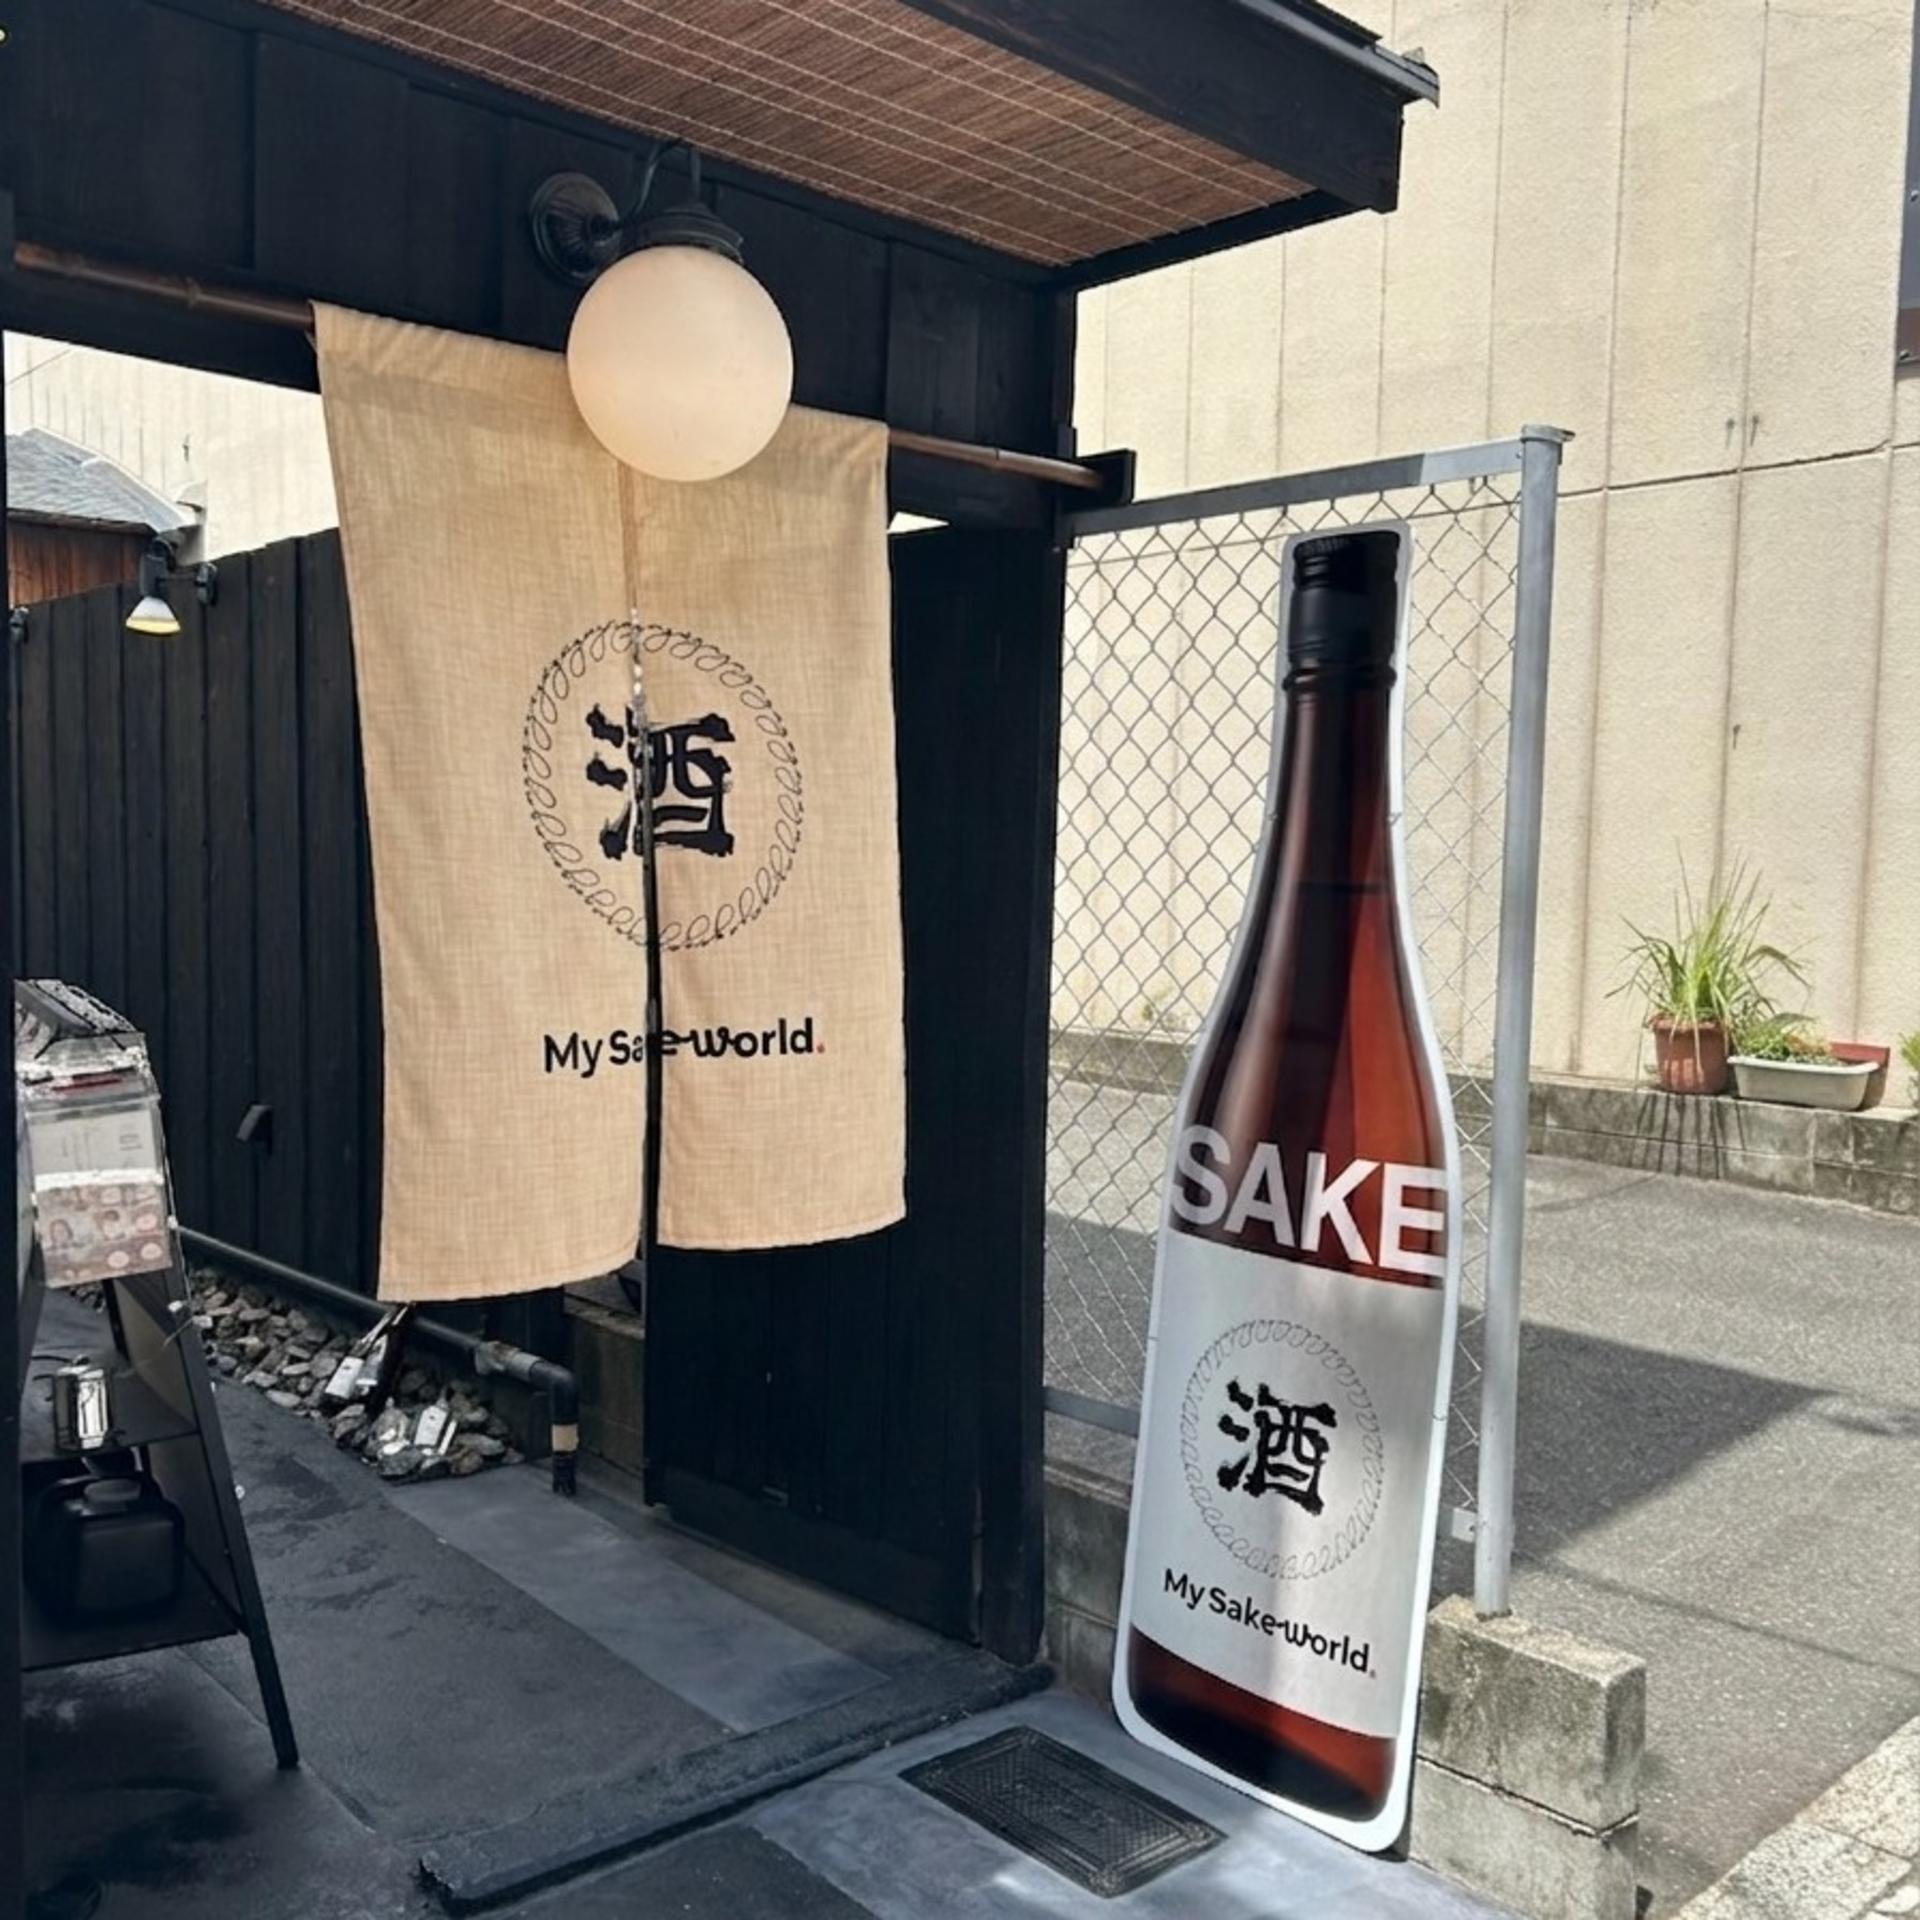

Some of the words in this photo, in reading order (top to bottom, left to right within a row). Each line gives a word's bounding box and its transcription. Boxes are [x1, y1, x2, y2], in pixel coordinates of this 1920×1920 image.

[586, 702, 735, 860] 酒
[543, 1031, 603, 1078] My
[1172, 1124, 1447, 1277] SAKE
[1217, 1373, 1338, 1517] 酒
[1164, 1567, 1205, 1611] My
